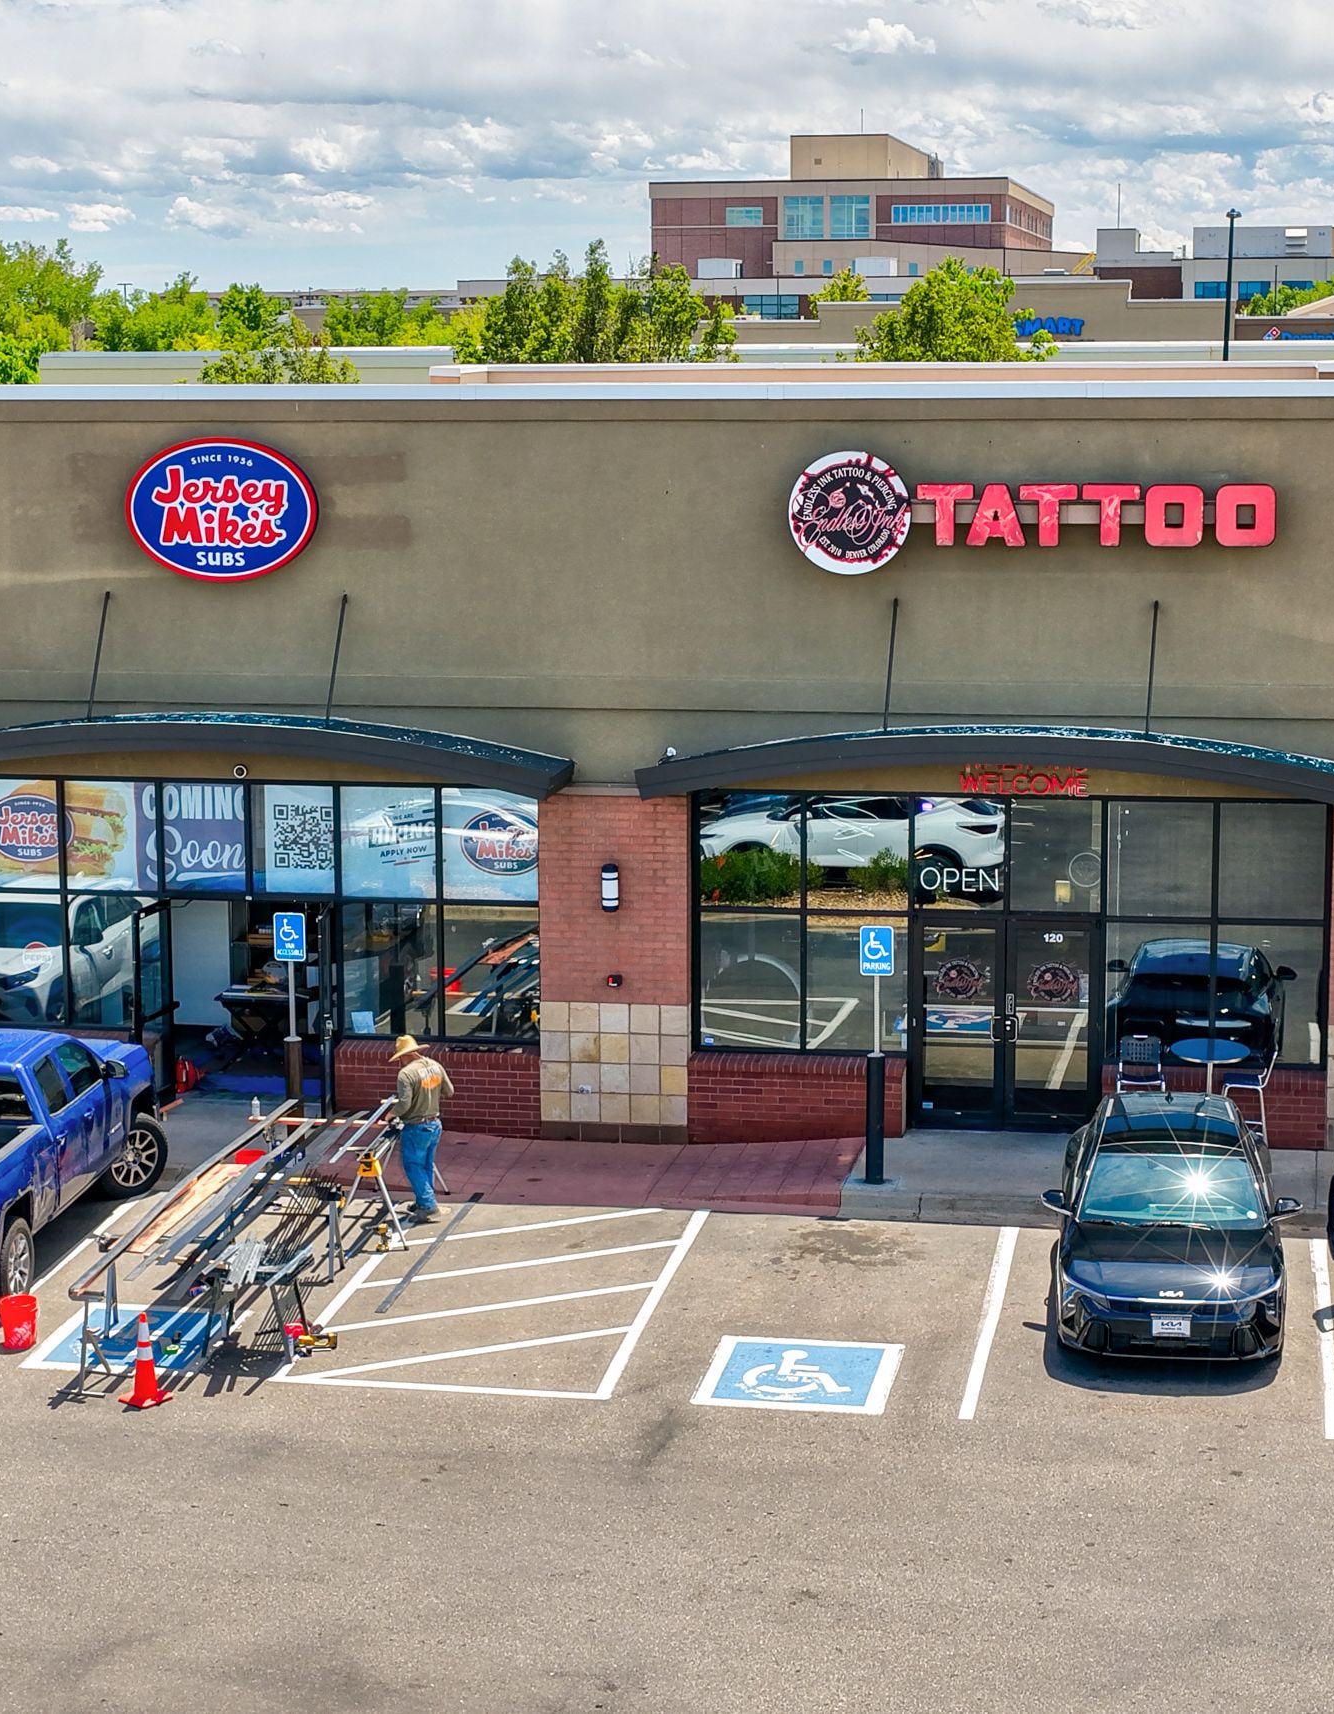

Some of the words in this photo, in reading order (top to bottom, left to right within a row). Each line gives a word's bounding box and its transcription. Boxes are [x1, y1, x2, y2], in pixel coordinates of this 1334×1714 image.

[190, 454, 222, 465] SINCE
[227, 454, 254, 467] 1956
[153, 467, 286, 517] Jersey
[803, 484, 822, 520] ENDLESS
[817, 472, 834, 488] INK
[832, 467, 865, 479] TATTOO
[864, 474, 872, 482] &
[871, 476, 898, 510] PIERCING
[161, 505, 285, 547] Mike's
[916, 483, 1277, 548] TATTOO
[845, 549, 868, 560] DENVER
[867, 529, 891, 554] COLORADO
[196, 551, 246, 567] SUBS
[959, 773, 1088, 797] WELCOME
[0, 826, 58, 848] Mike's
[17, 848, 43, 857] SUBS
[146, 825, 246, 883] Soon
[380, 849, 404, 858] APPLY
[407, 845, 427, 854] NOW
[493, 861, 519, 869] SUBS
[920, 866, 999, 893] OPEN
[1043, 933, 1063, 943] 120
[862, 961, 892, 971] PARKING
